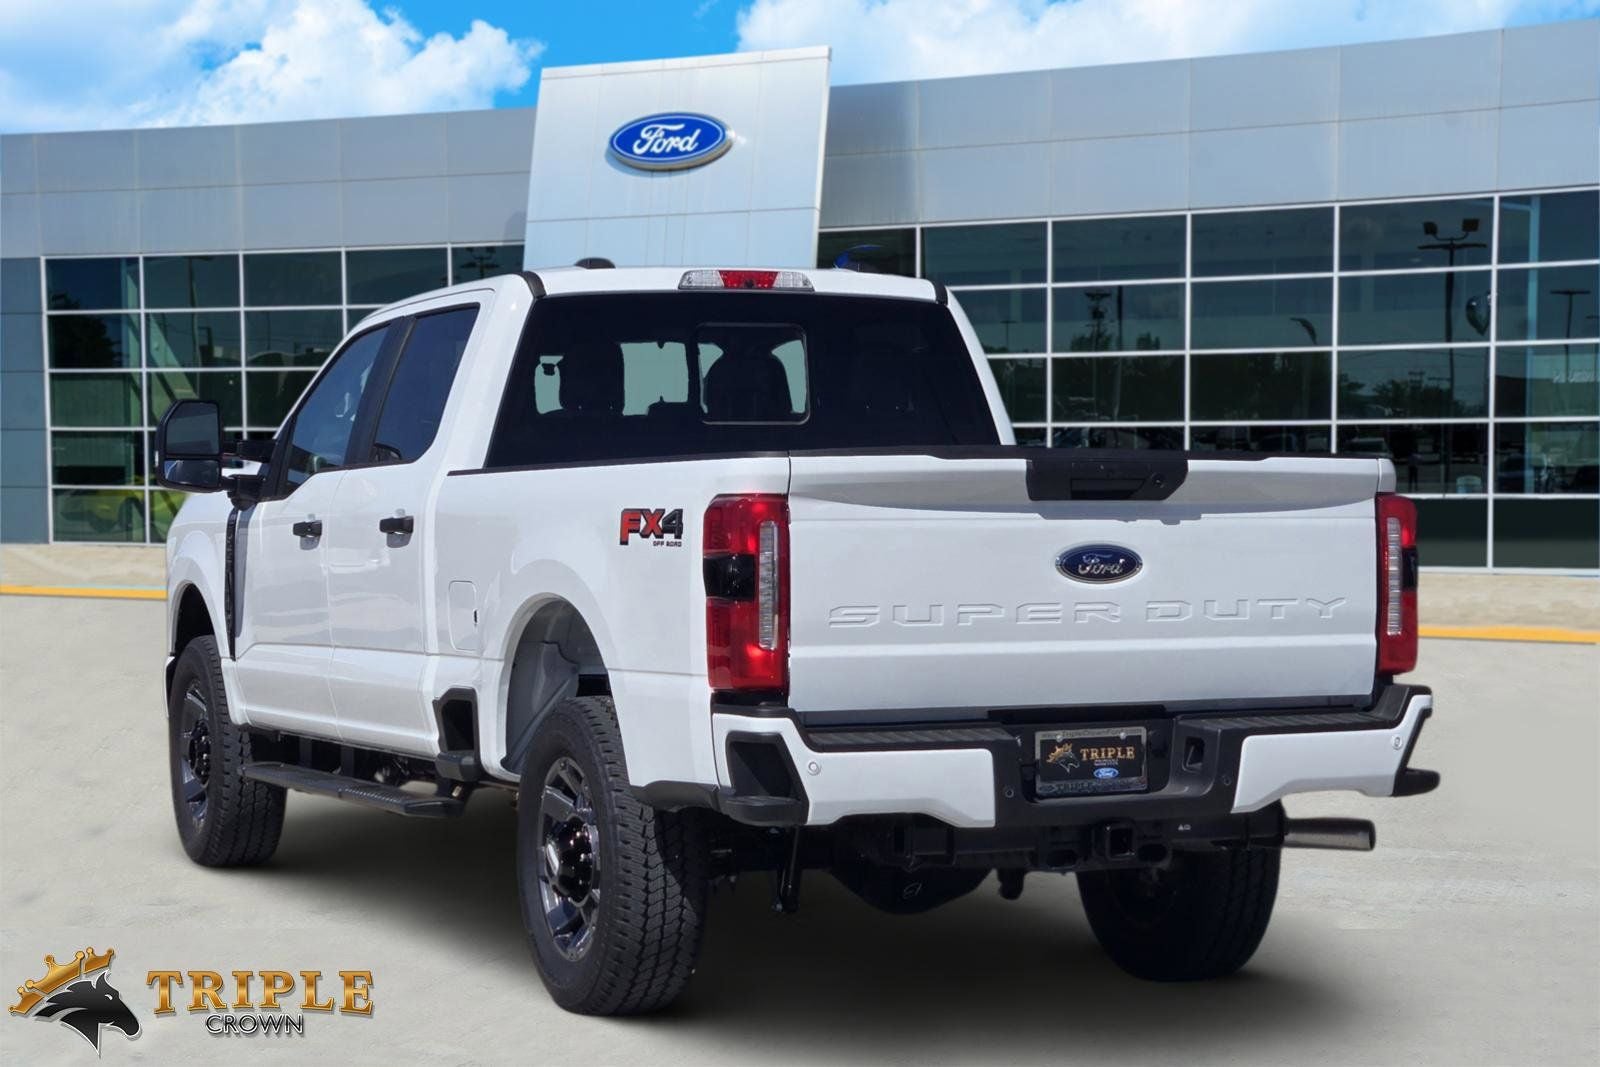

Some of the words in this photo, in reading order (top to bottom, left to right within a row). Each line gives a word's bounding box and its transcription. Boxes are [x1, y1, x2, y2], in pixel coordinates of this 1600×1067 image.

[632, 123, 701, 155] Ford
[619, 508, 684, 546] FX4
[1078, 553, 1125, 575] Ford
[828, 602, 1121, 628] SUPER
[1145, 597, 1347, 622] DUTY
[1080, 747, 1135, 761] TRIPLE
